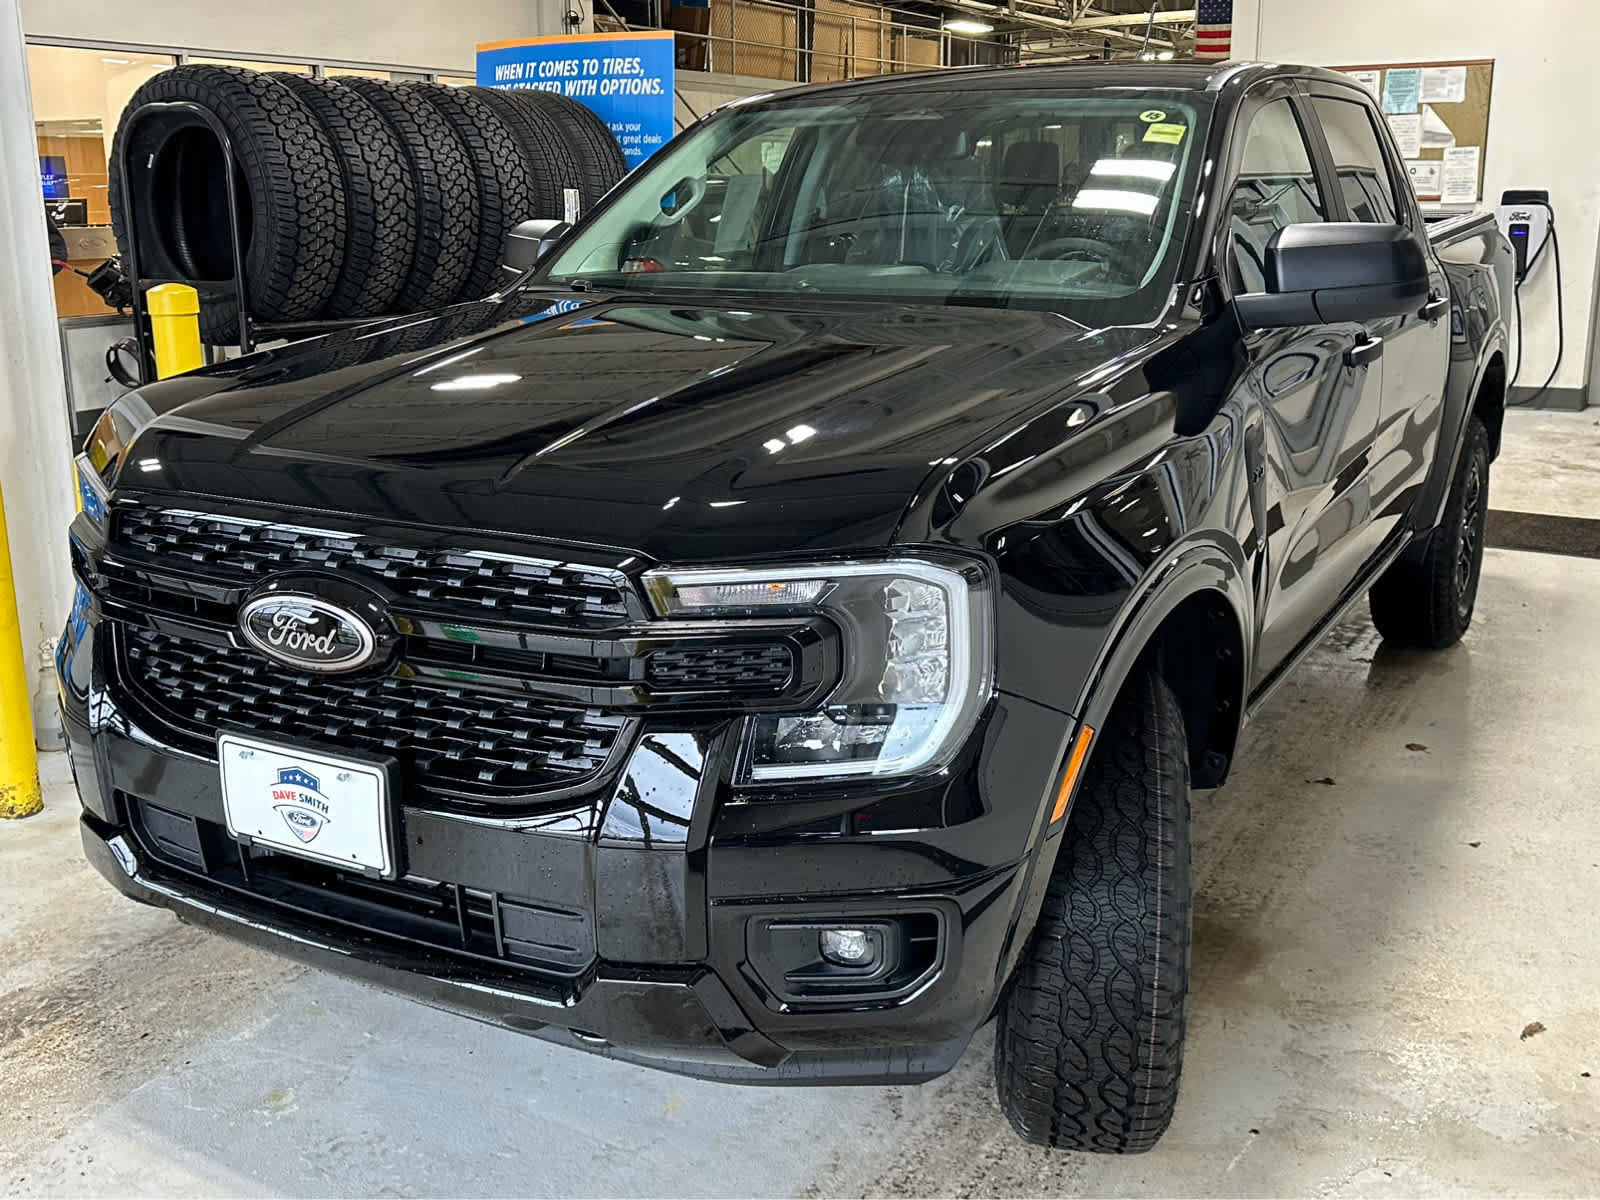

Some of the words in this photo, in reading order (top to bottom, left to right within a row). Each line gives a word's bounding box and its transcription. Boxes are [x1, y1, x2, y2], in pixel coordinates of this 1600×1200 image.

[495, 63, 524, 81] WHEN
[525, 62, 536, 78] IT
[538, 60, 579, 78] COMES
[582, 58, 599, 76] TO
[602, 57, 645, 77] TIRES,
[564, 79, 597, 96] WITH
[600, 78, 664, 96] OPTIONS.
[611, 121, 625, 131] ask
[625, 123, 641, 133] your
[622, 134, 642, 145] great
[643, 133, 662, 144] deals
[621, 146, 644, 156] rands.
[267, 610, 337, 655] Ford
[272, 790, 297, 801] DAVE
[298, 793, 329, 814] SMITH
[292, 812, 313, 825] Ford
